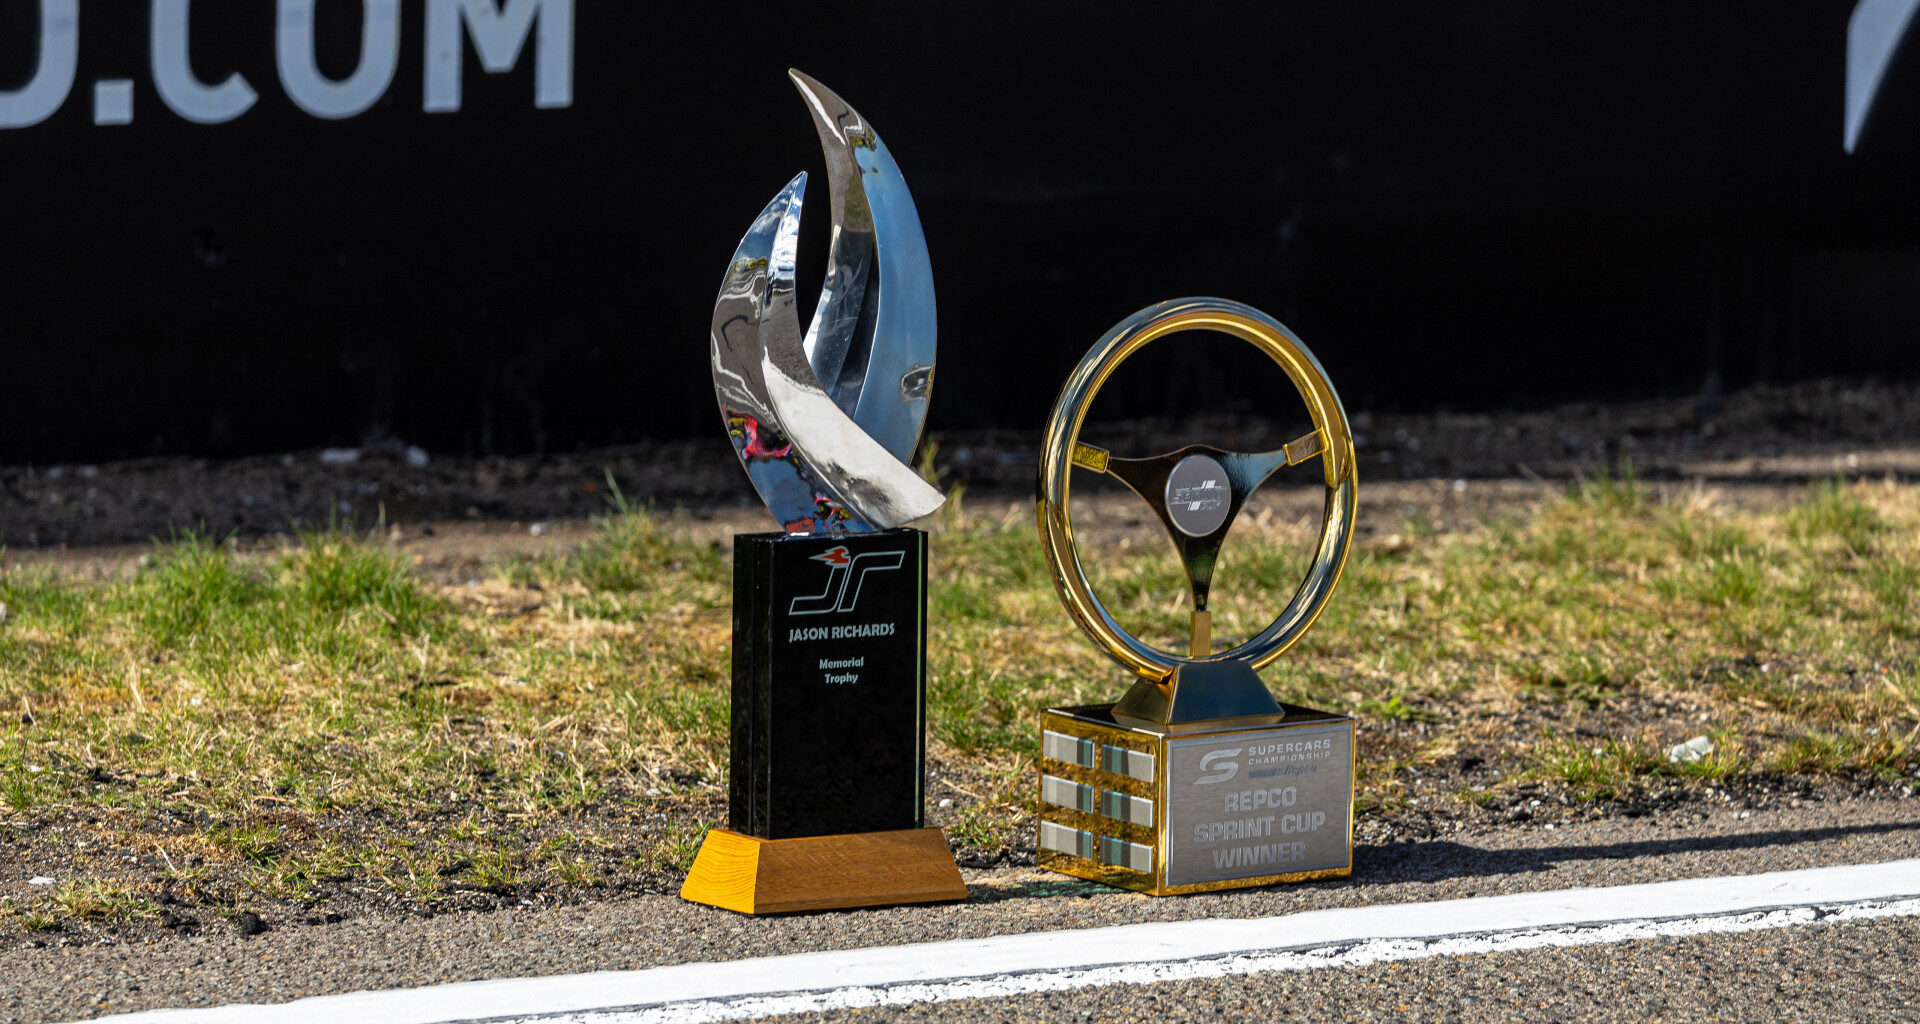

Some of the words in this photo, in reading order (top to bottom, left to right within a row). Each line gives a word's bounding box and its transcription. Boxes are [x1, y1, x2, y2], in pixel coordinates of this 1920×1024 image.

[789, 627, 828, 643] JASON
[831, 622, 895, 639] RICHARDS
[819, 656, 864, 669] Memorial
[824, 673, 858, 685] Trophy
[1248, 739, 1331, 756] SUPERCARS
[1248, 750, 1331, 766] CHAMPIONSHIP
[1224, 786, 1297, 812] REPCO
[1194, 816, 1274, 843] SPRINT
[1281, 810, 1326, 834] CUP
[1213, 841, 1306, 869] WINNER
